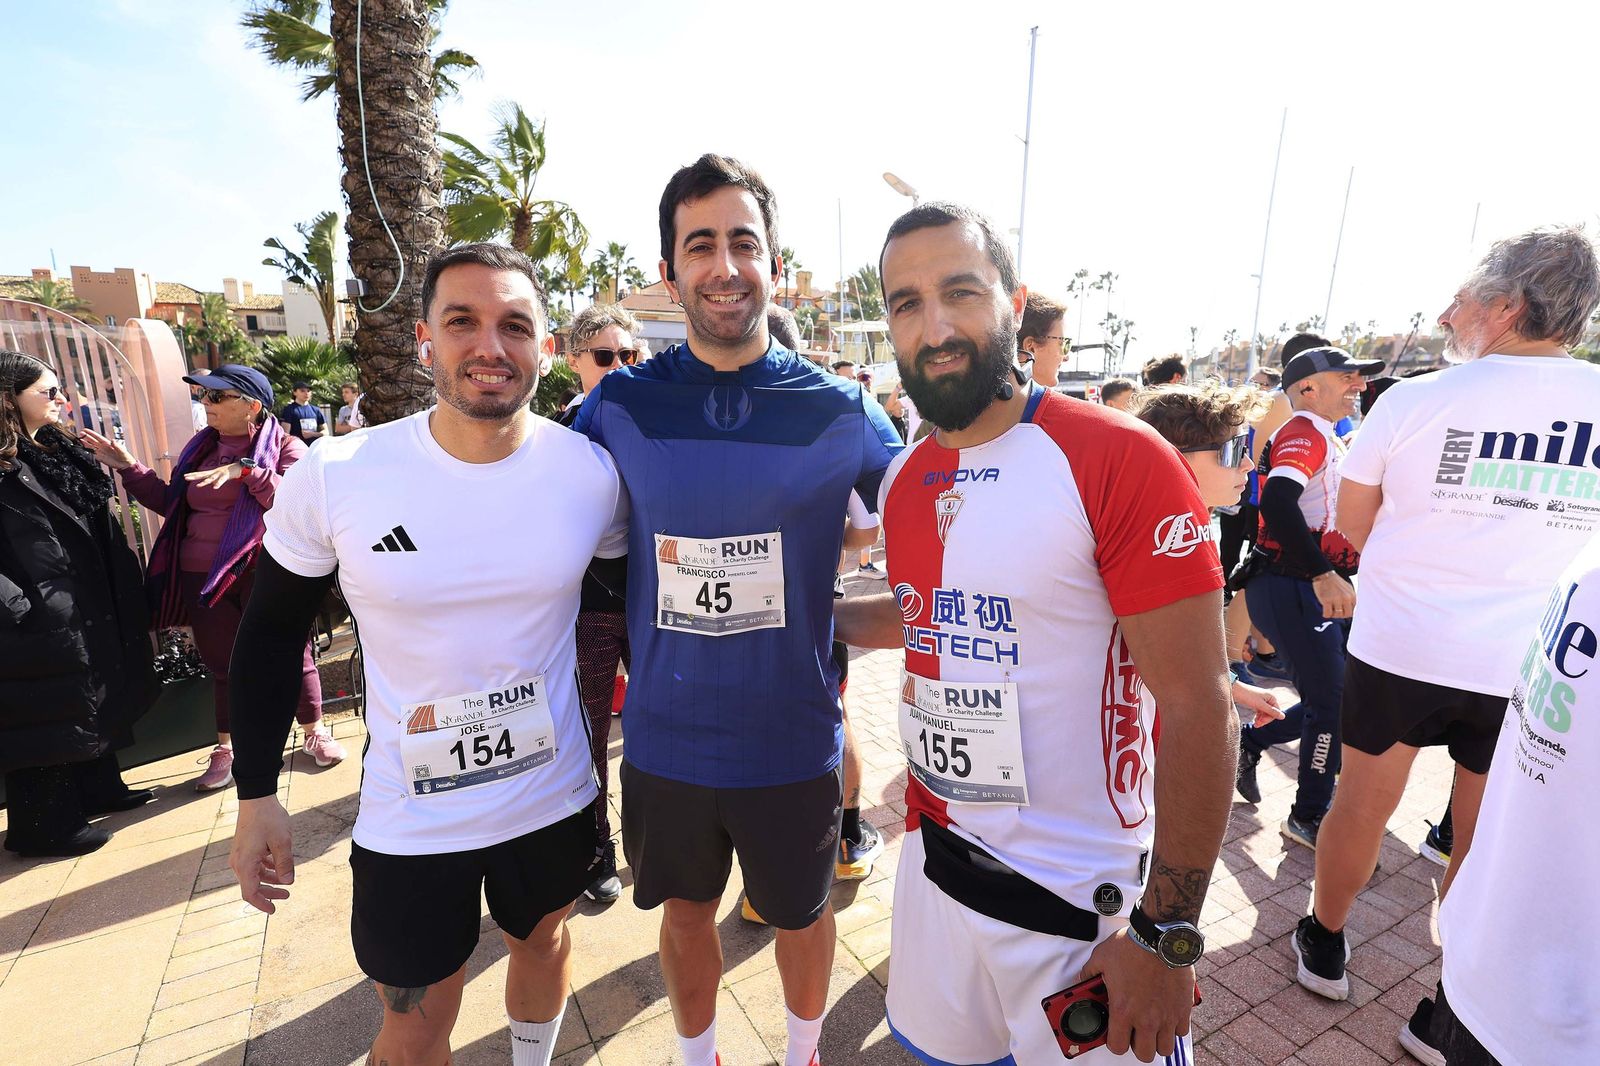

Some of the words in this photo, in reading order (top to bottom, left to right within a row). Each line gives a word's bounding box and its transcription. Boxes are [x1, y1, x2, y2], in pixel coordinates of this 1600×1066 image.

[1435, 427, 1475, 486] EVERY
[924, 467, 1000, 486] GIVOVA
[1468, 462, 1600, 500] MATTER
[1546, 520, 1593, 532] BETANIA
[698, 543, 717, 554] The
[721, 538, 769, 558] RUN
[730, 556, 747, 565] Charity
[747, 554, 770, 562] Challenge
[677, 566, 726, 579] FRANCISCO
[695, 581, 733, 614] 45
[932, 587, 1017, 634] 威视
[462, 697, 484, 710] The
[488, 682, 536, 709] RUN
[925, 684, 940, 699] The
[944, 687, 1002, 709] RUN
[498, 704, 515, 714] Charity
[515, 698, 537, 708] Challenge
[954, 709, 974, 717] Charity
[974, 709, 1003, 718] Challenge
[1114, 632, 1141, 794] PMC
[909, 707, 922, 722] JUAN
[922, 714, 956, 732] MANUEL
[460, 723, 487, 736] JOSE
[449, 728, 516, 771] 154
[538, 740, 545, 748] M
[919, 728, 972, 778] 155
[1527, 754, 1555, 770] school
[1002, 771, 1011, 780] M
[982, 791, 1016, 799] BETANIA
